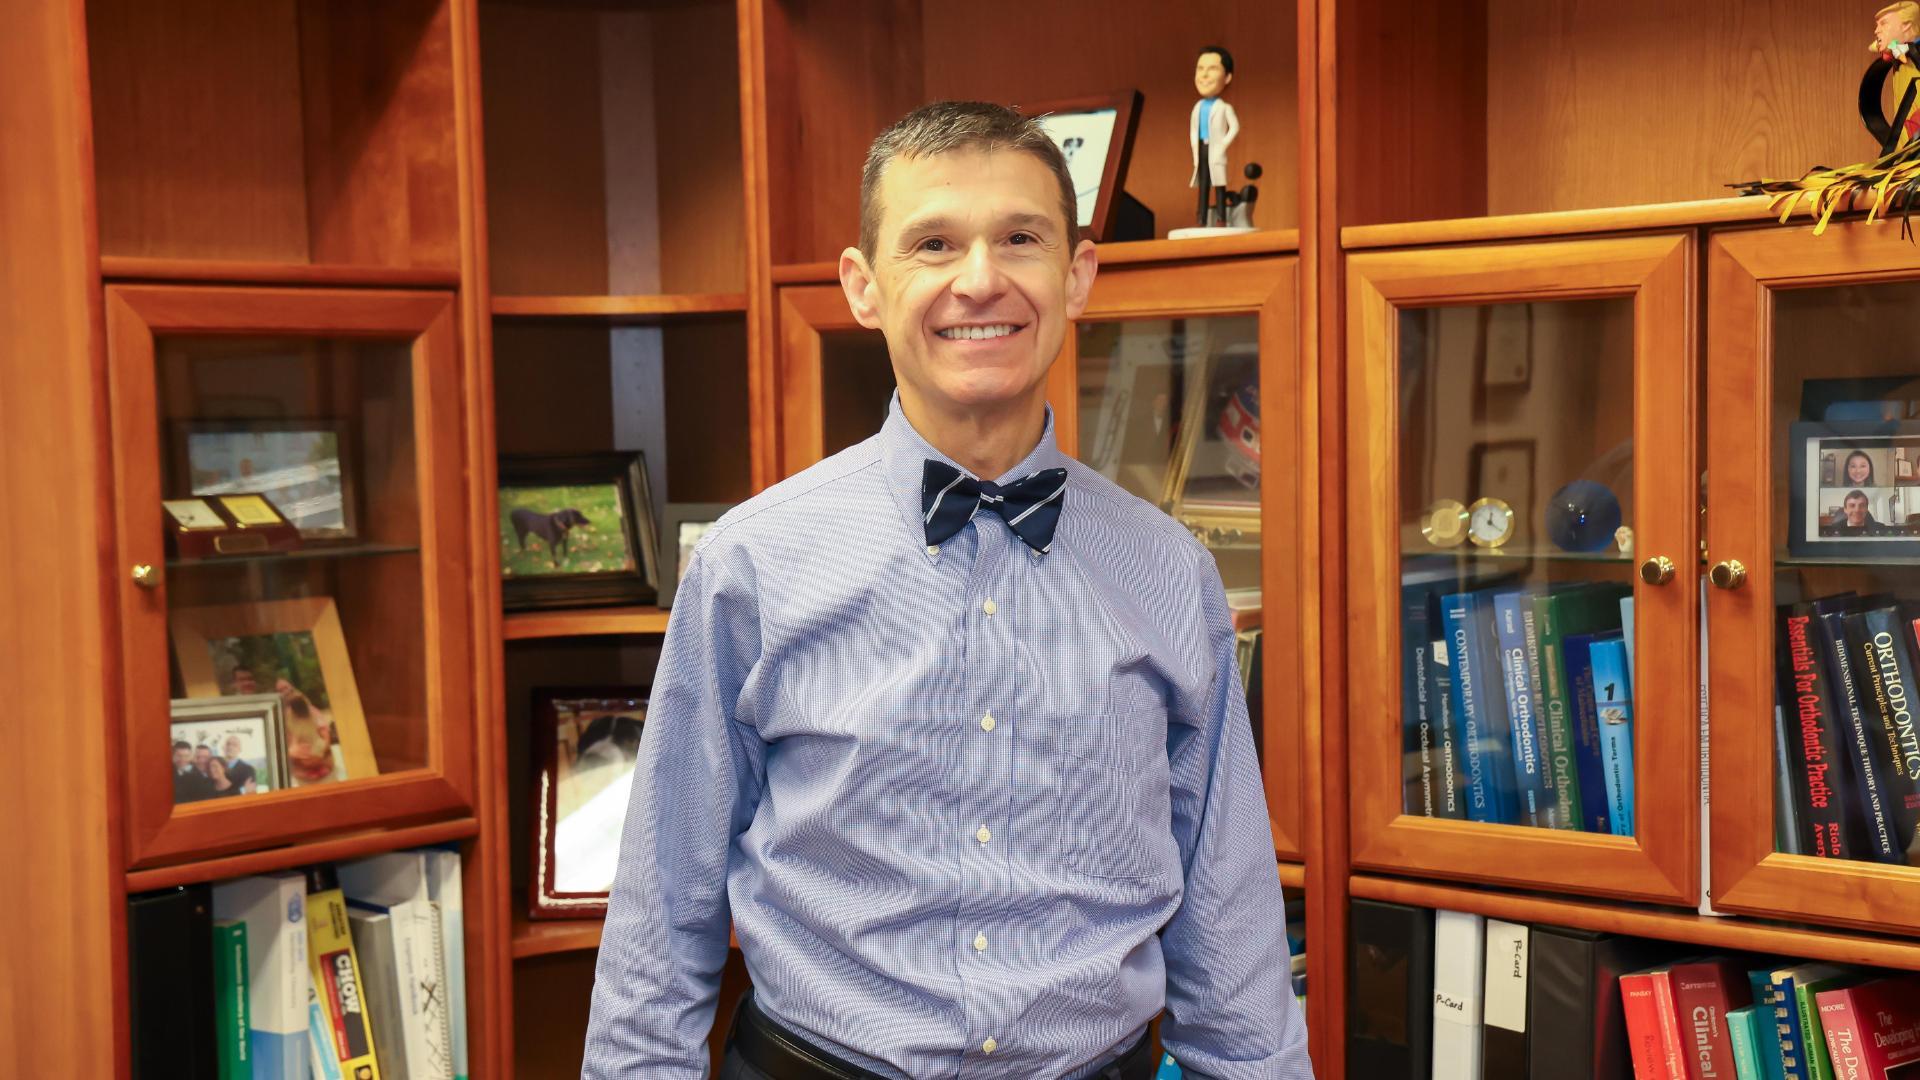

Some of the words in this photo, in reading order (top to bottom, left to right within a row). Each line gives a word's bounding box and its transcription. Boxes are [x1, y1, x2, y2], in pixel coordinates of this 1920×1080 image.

[1788, 616, 1816, 671] Essentials
[1416, 647, 1429, 704] Dentofacial
[1512, 648, 1526, 692] Clinical
[1797, 673, 1817, 692] For
[1836, 639, 1856, 705] BIDIMENSIONAL
[1420, 704, 1428, 720] and
[1455, 629, 1475, 718] CONTEMPORARY
[1467, 719, 1485, 809] ORTHODONTICS
[1549, 700, 1567, 752] Clinical
[1798, 695, 1824, 762] Orthodontic
[1864, 642, 1877, 671] Current
[1872, 672, 1888, 714] Principles
[1883, 715, 1891, 730] and
[1887, 730, 1903, 776] Techniques
[1874, 631, 1920, 781] ORTHODONTICS
[1420, 722, 1431, 765] Occlusal
[1518, 694, 1535, 775] Orthodontics
[1610, 737, 1618, 760] Terms
[1850, 705, 1868, 757] TECHNIQUE
[1443, 741, 1456, 812] ORTHODONTICS
[1612, 763, 1623, 811] Orthodontic
[1807, 763, 1831, 808] Practice
[1862, 757, 1877, 791] THEORY
[1870, 790, 1881, 812] AND
[1814, 823, 1826, 857] Avery
[1829, 822, 1841, 856] Riolo
[1874, 811, 1890, 856] PRACTICE
[335, 953, 361, 1014] CHOW
[1436, 995, 1463, 1011] P-Card
[1821, 1003, 1845, 1013] MOORE
[1876, 1011, 1893, 1026] The
[1692, 1006, 1718, 1078] Clinical
[1800, 1001, 1812, 1040] ILLUSTRATED
[1806, 1043, 1815, 1064] HUMAN
[1828, 1030, 1841, 1064] CLINICALLY
[1838, 1028, 1852, 1055] The
